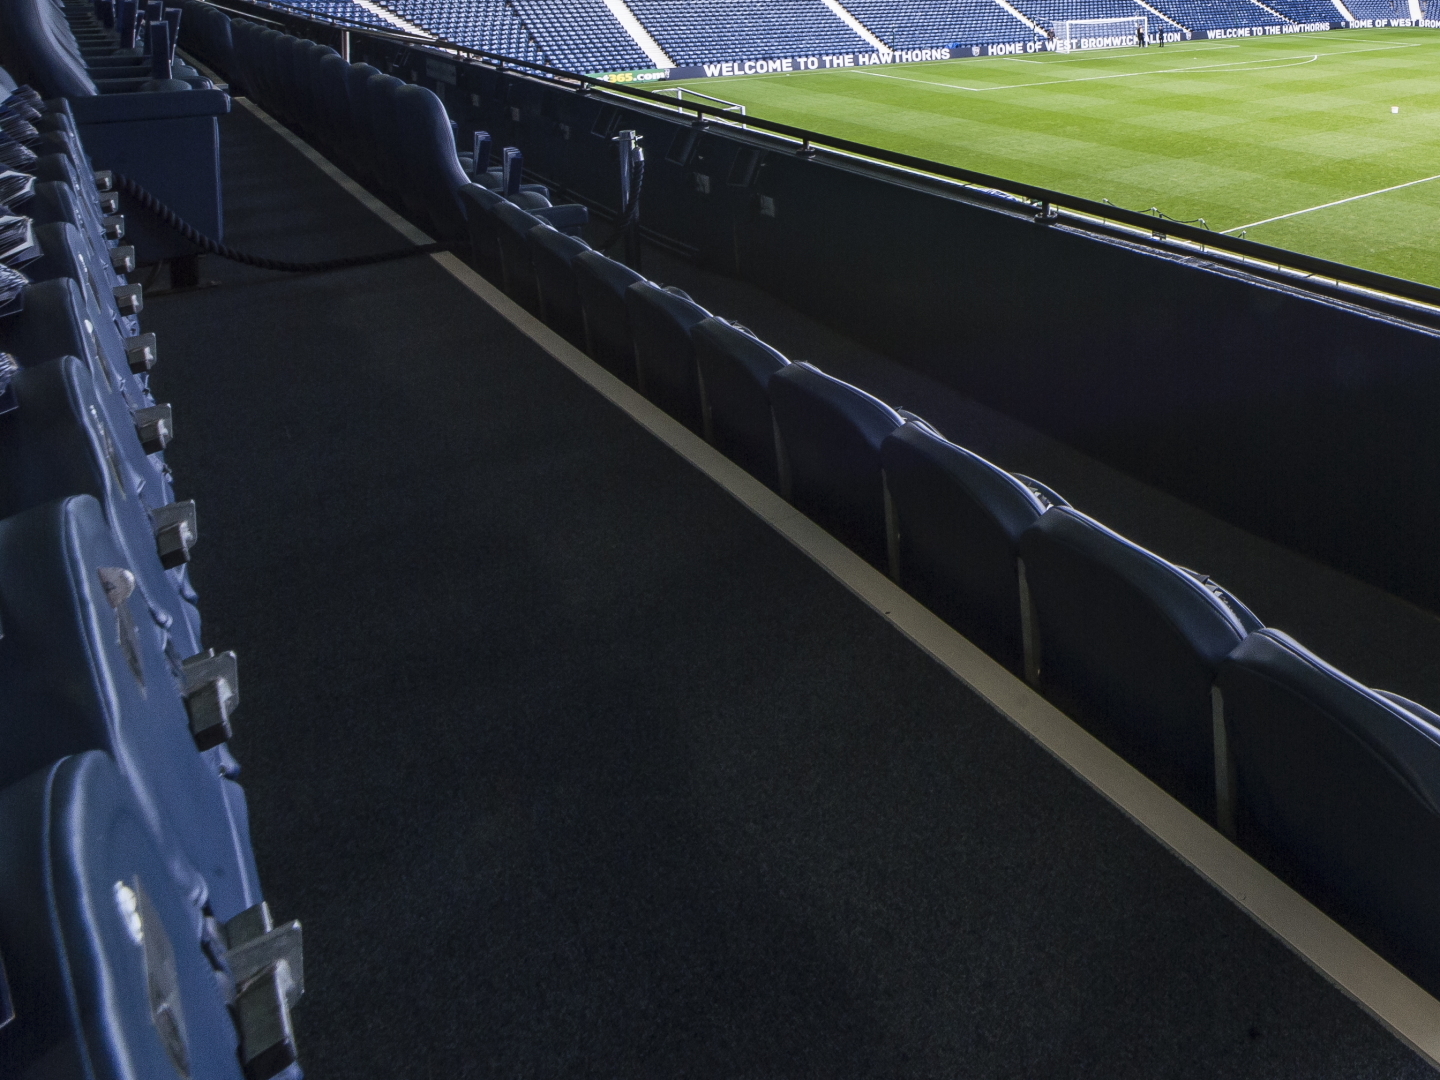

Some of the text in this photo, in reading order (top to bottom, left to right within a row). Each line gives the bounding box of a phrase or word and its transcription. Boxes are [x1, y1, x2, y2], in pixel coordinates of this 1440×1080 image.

[1207, 22, 1330, 40] WELCOME TO THE HAWTHORNS
[1350, 20, 1373, 29] HOME
[1375, 19, 1388, 28] OF
[1389, 19, 1416, 28] WEST
[988, 42, 1023, 56] HOME
[1026, 41, 1043, 53] OF
[1045, 39, 1078, 52] WEST
[703, 48, 950, 78] WELCOME TO THE HAWTHORNS
